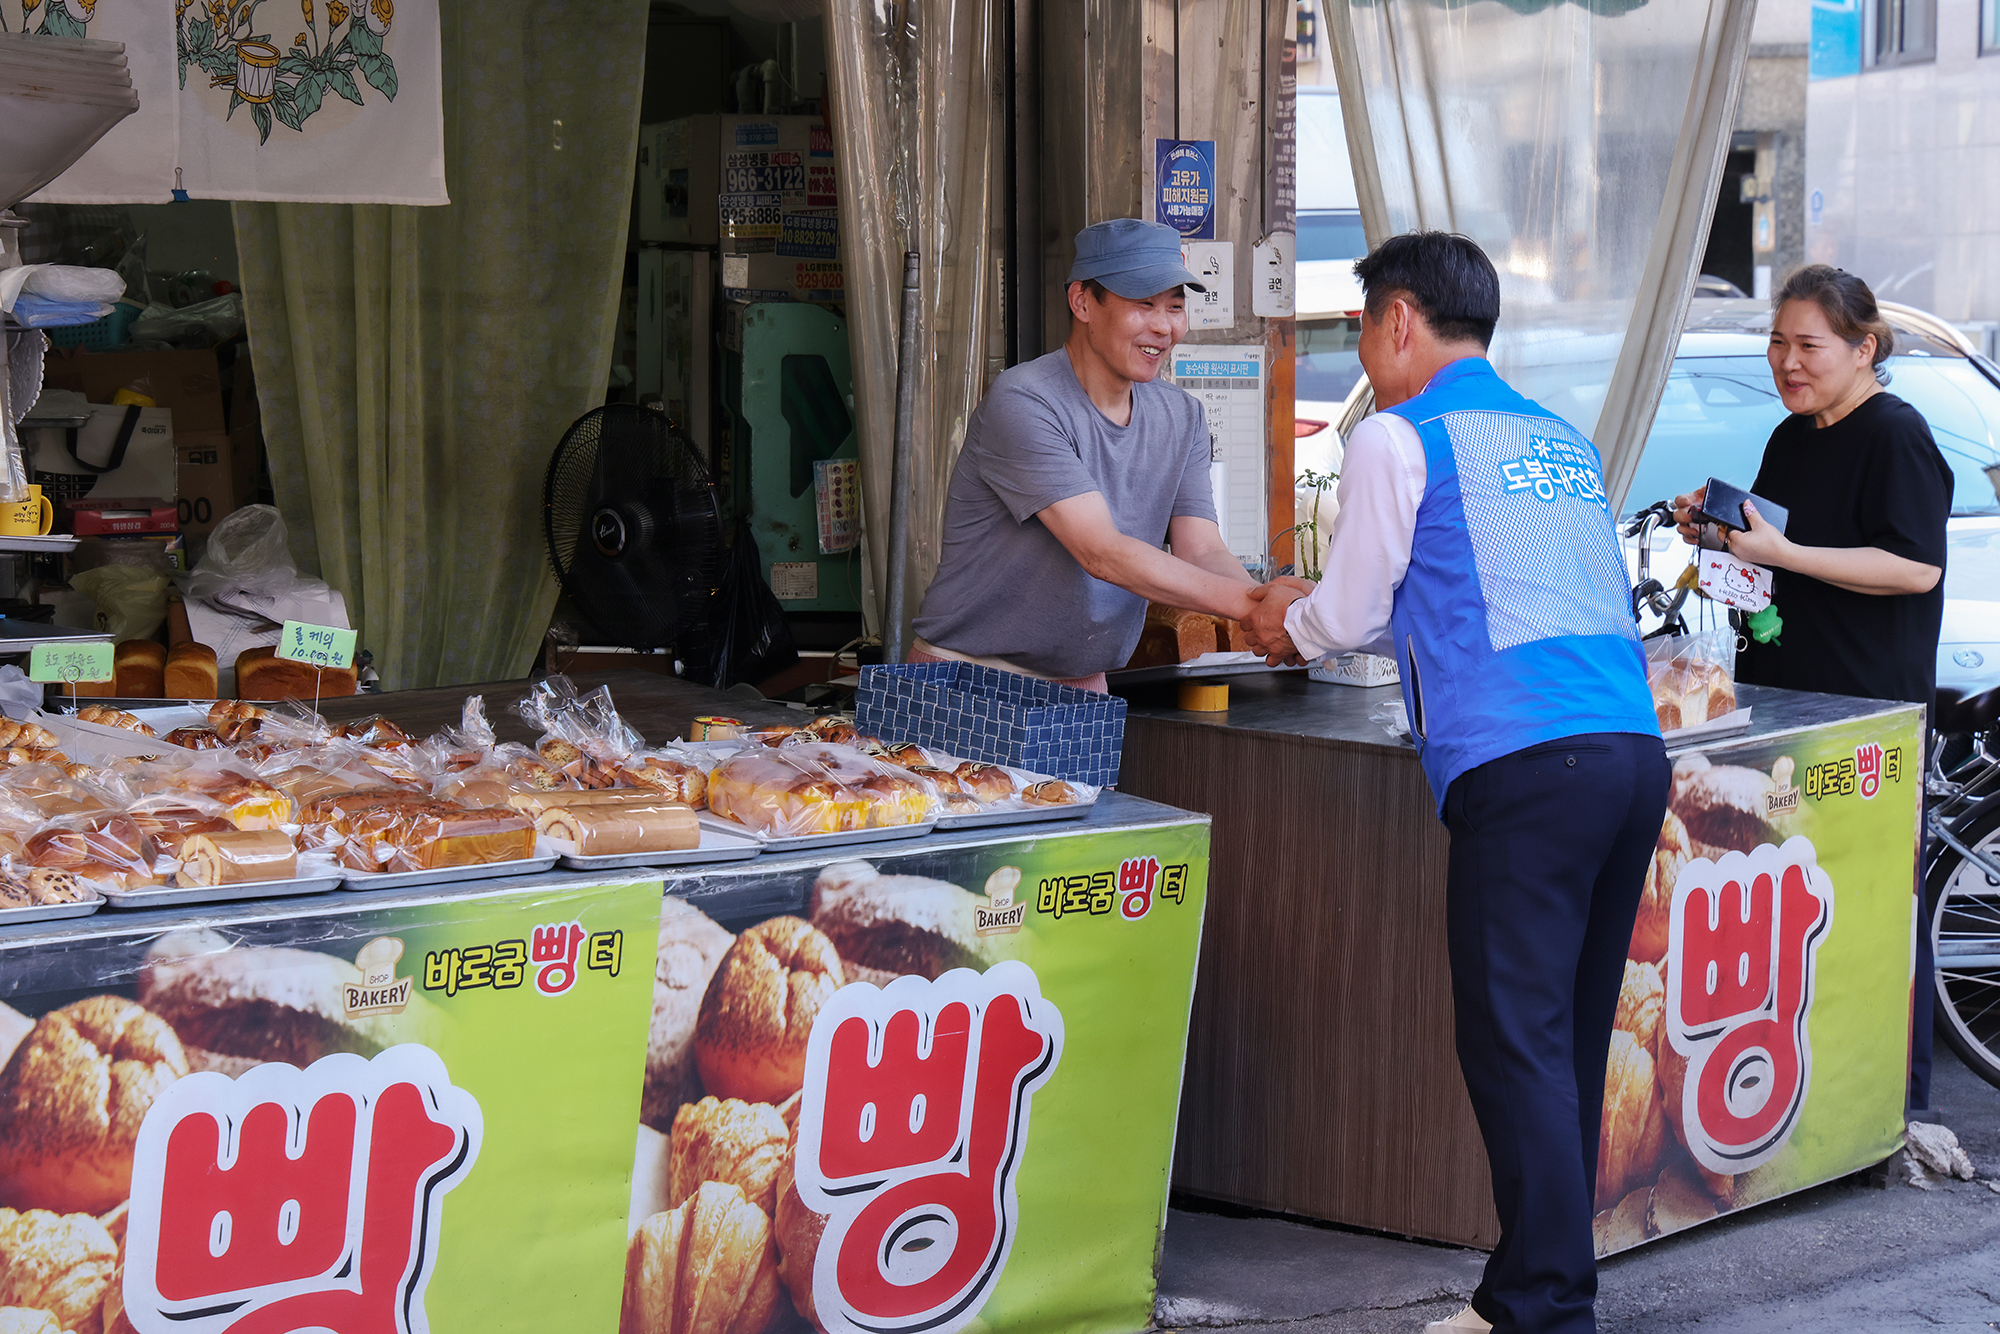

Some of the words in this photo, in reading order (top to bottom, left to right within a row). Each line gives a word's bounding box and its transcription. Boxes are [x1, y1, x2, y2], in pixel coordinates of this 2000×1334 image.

[727, 153, 769, 168] 삼성냉동
[727, 166, 804, 192] 966-3122
[1171, 170, 1200, 186] 고유가
[721, 195, 754, 207] 우성냉동
[756, 194, 780, 206] 써비스
[1163, 187, 1208, 204] 피해지원금
[1167, 205, 1204, 216] 사용가능매장
[783, 216, 837, 230] G종합냉동상사
[1269, 278, 1282, 290] 금연
[1205, 291, 1218, 302] 금연
[1185, 362, 1210, 375] 농수산물
[1211, 362, 1230, 375] 원산지
[1230, 363, 1249, 375] 표시판
[1502, 458, 1607, 509] 도봉대전환
[112, 522, 141, 531] 위생장갑
[1719, 589, 1738, 599] Hello
[1740, 595, 1757, 607] Kitty
[64, 651, 96, 667] 파운드
[331, 651, 344, 666] 원
[87, 666, 100, 679] 원
[1768, 790, 1799, 810] BAKERY
[994, 898, 1011, 907] SHOP
[977, 905, 1024, 928] BAKERY
[369, 973, 390, 984] SHOP
[346, 981, 409, 1008] BAKERY
[1678, 862, 1825, 1150] 빵
[814, 990, 1052, 1324] 빵
[152, 1078, 470, 1334] 빵
